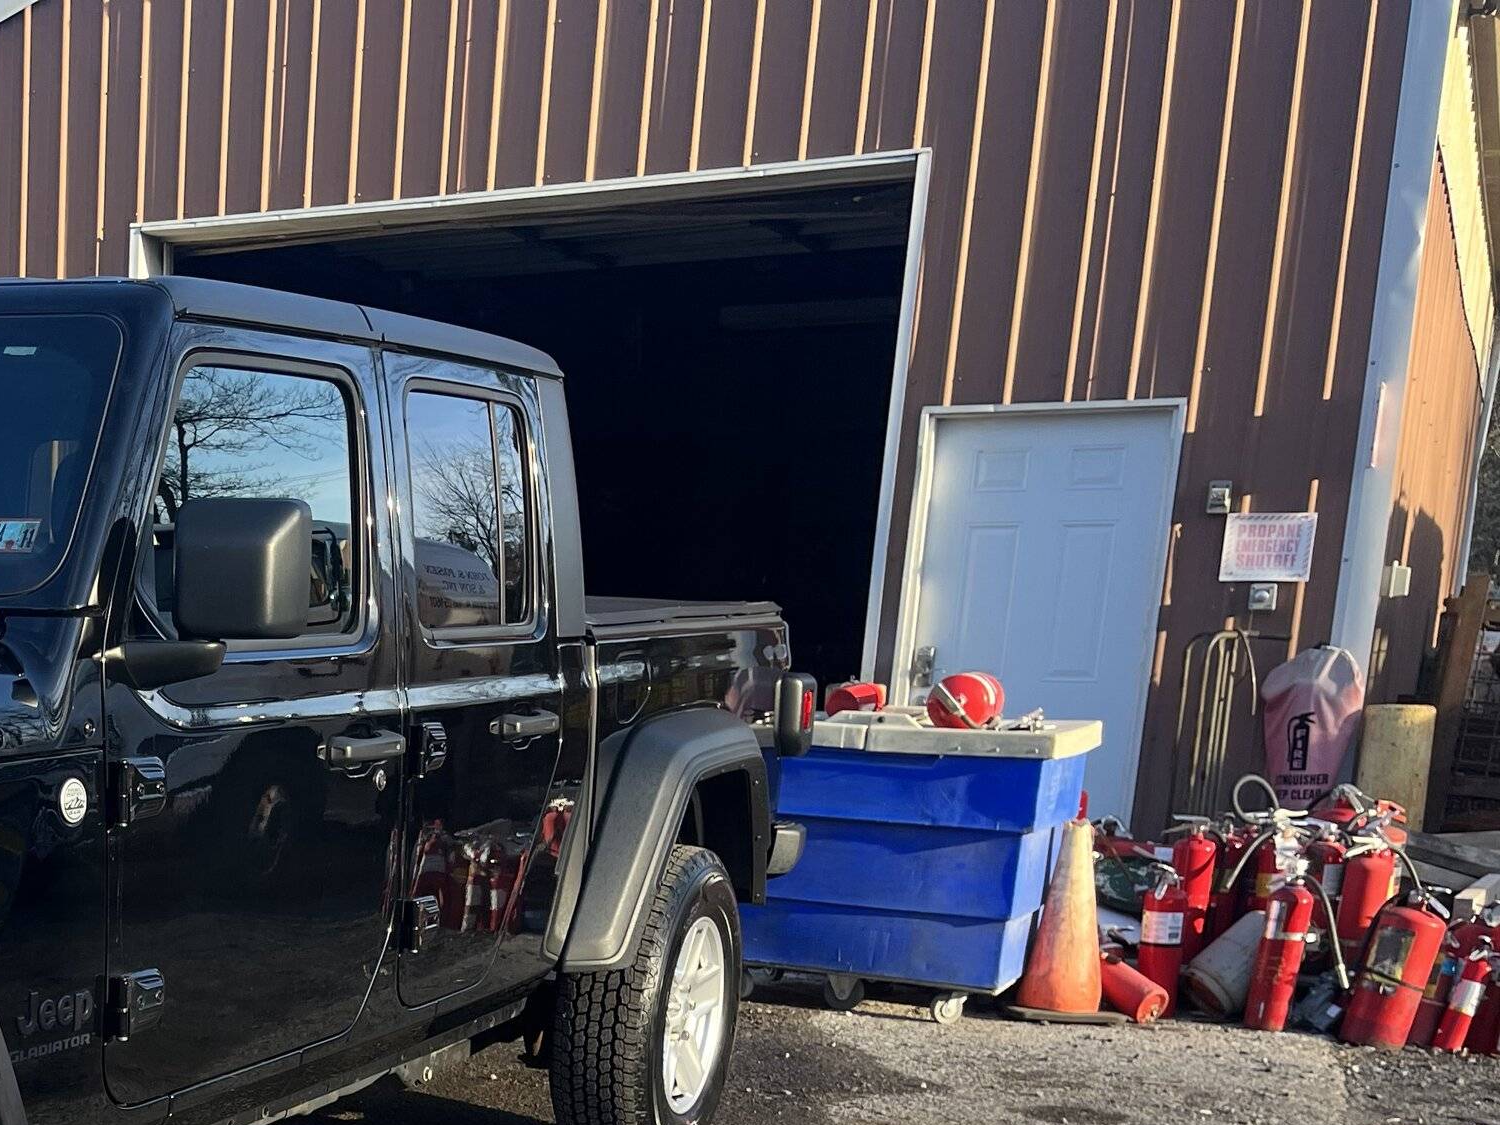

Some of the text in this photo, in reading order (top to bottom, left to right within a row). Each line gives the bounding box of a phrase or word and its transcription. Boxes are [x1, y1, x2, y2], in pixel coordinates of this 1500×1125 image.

[1237, 523, 1303, 539] PROPANE
[1235, 539, 1301, 553] EMERGENCY
[1235, 554, 1298, 569] SHUTOFF
[17, 990, 93, 1035] Jeep
[8, 1033, 91, 1062] GLADIATOR
